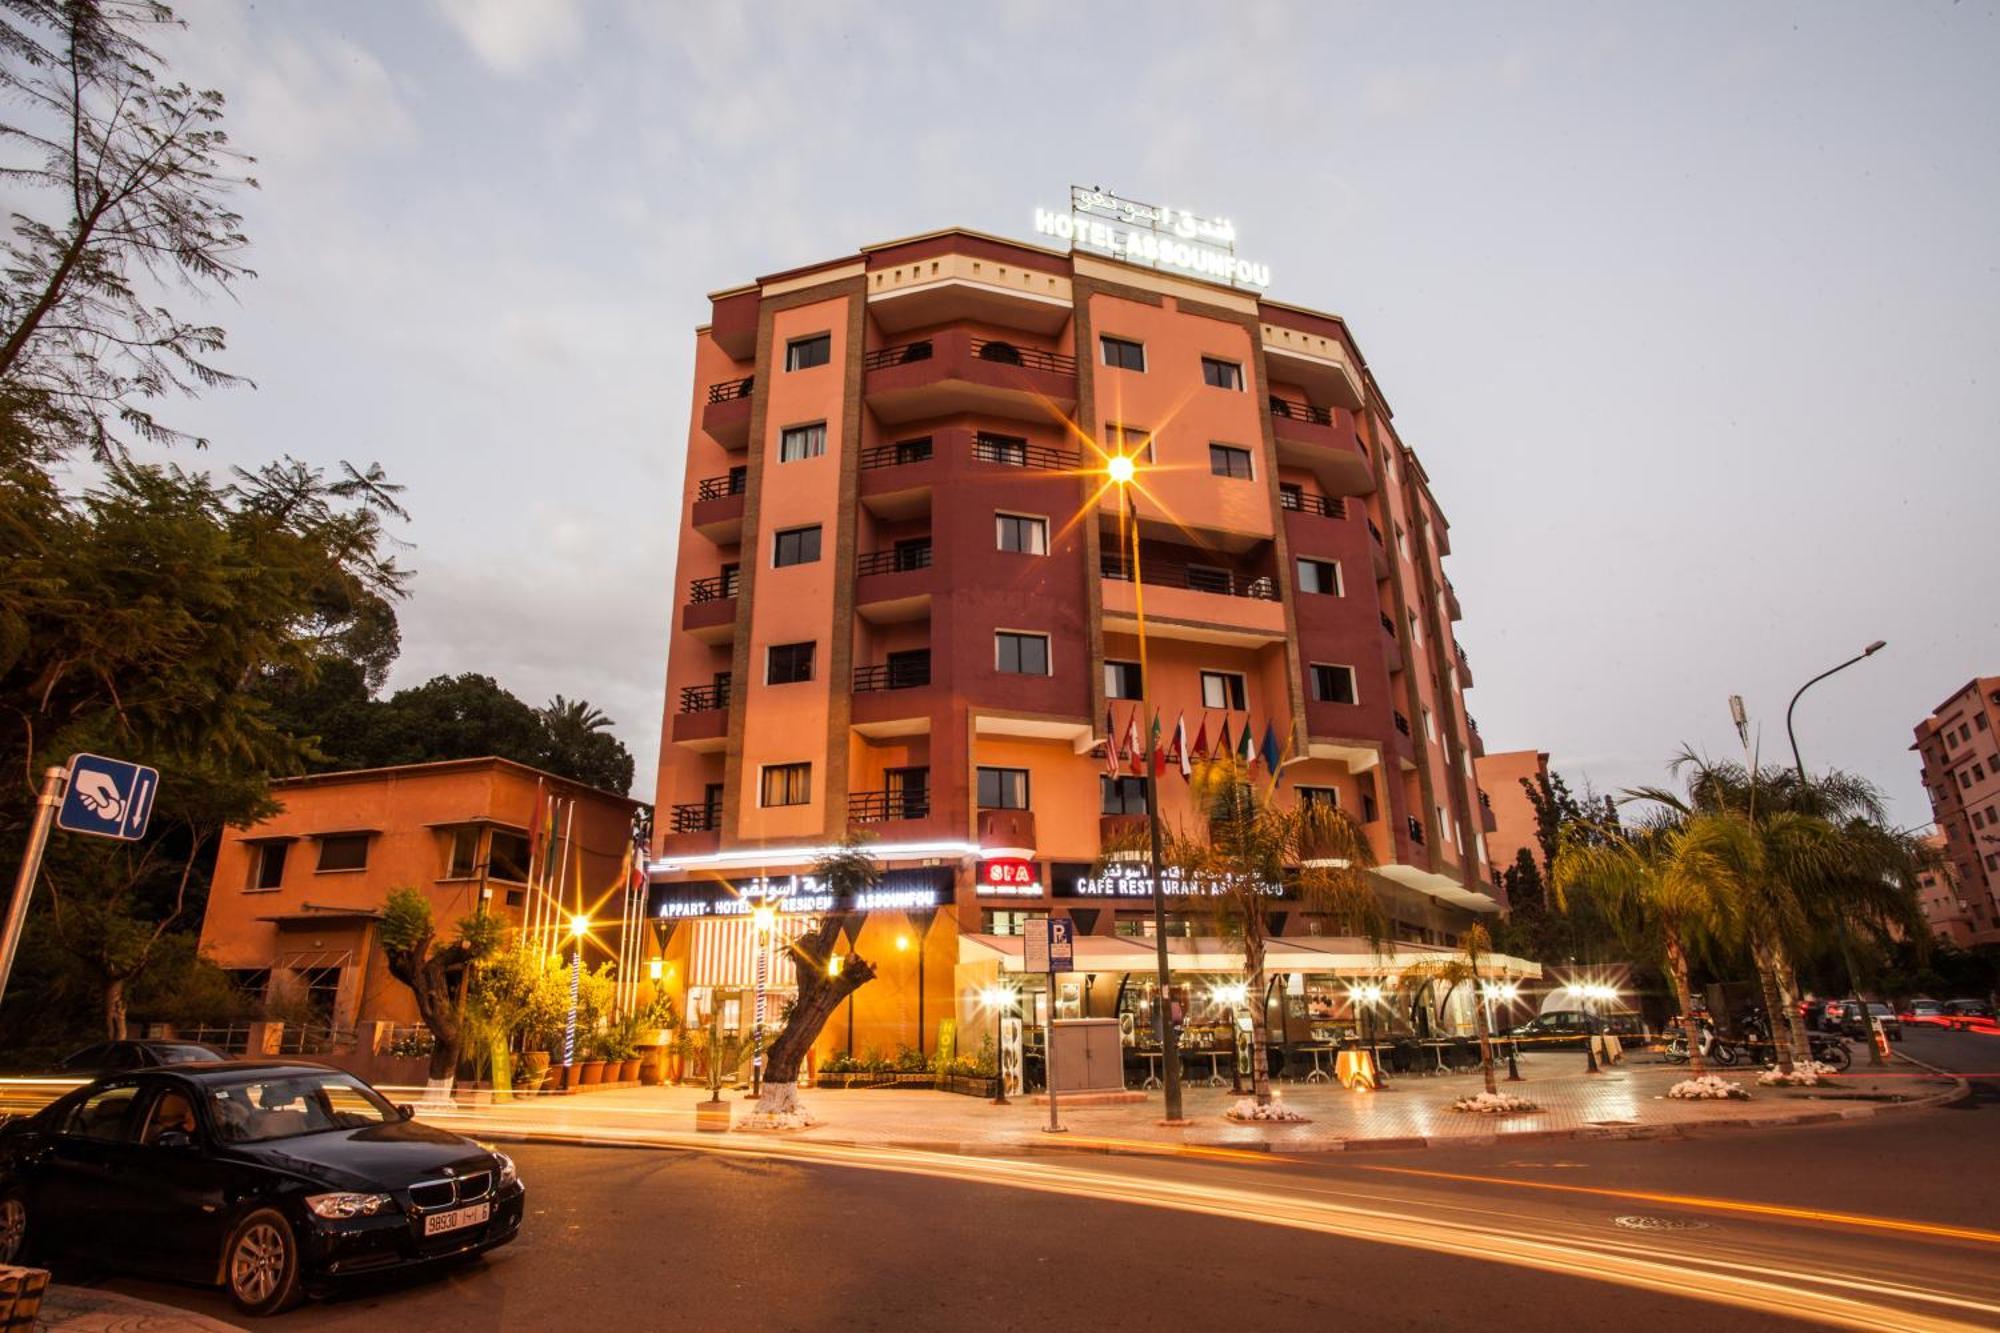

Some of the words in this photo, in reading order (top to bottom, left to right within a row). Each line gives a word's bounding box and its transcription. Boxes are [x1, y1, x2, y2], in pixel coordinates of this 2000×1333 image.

[1035, 207, 1123, 251] HOTEL
[989, 864, 1030, 882] SPA
[1119, 878, 1206, 895] RESTURANT
